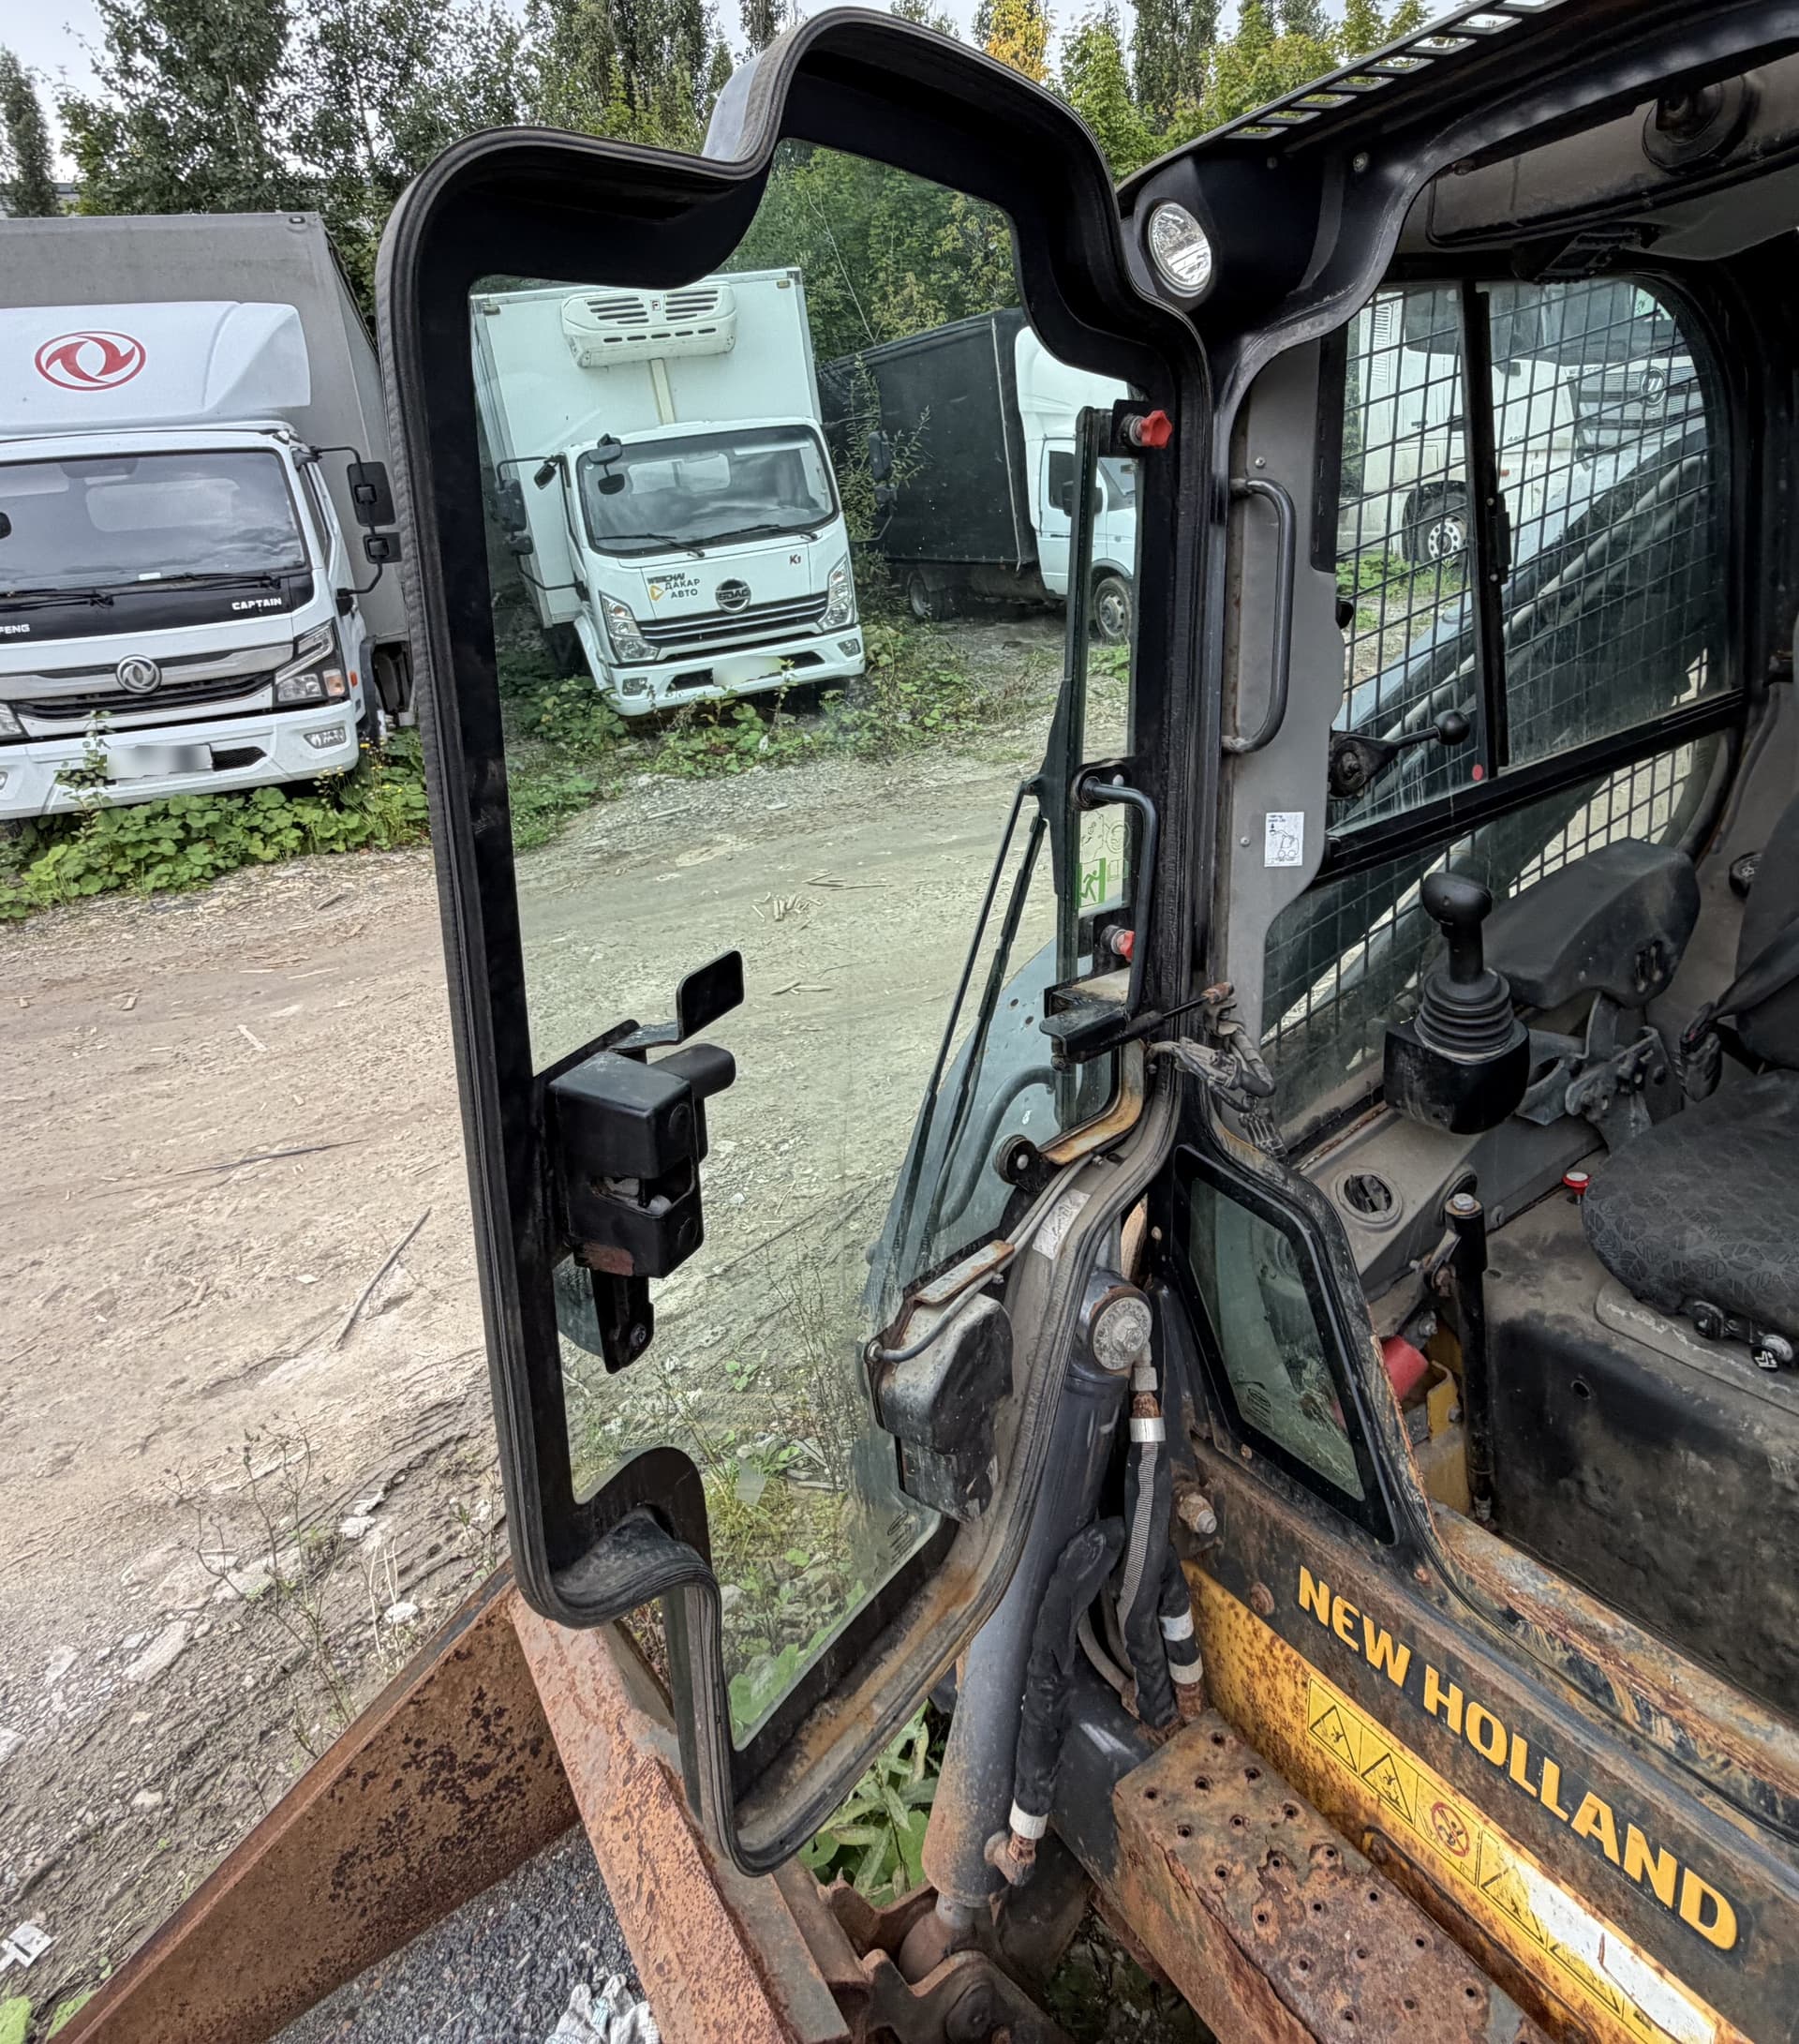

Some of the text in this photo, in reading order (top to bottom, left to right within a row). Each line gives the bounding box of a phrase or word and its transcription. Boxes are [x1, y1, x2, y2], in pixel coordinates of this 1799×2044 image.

[665, 578, 701, 590] ДАКАР
[671, 589, 698, 599] АВТО
[231, 598, 282, 610] CAPTAIN
[1299, 1565, 1738, 1950] NEW HOLLAND
